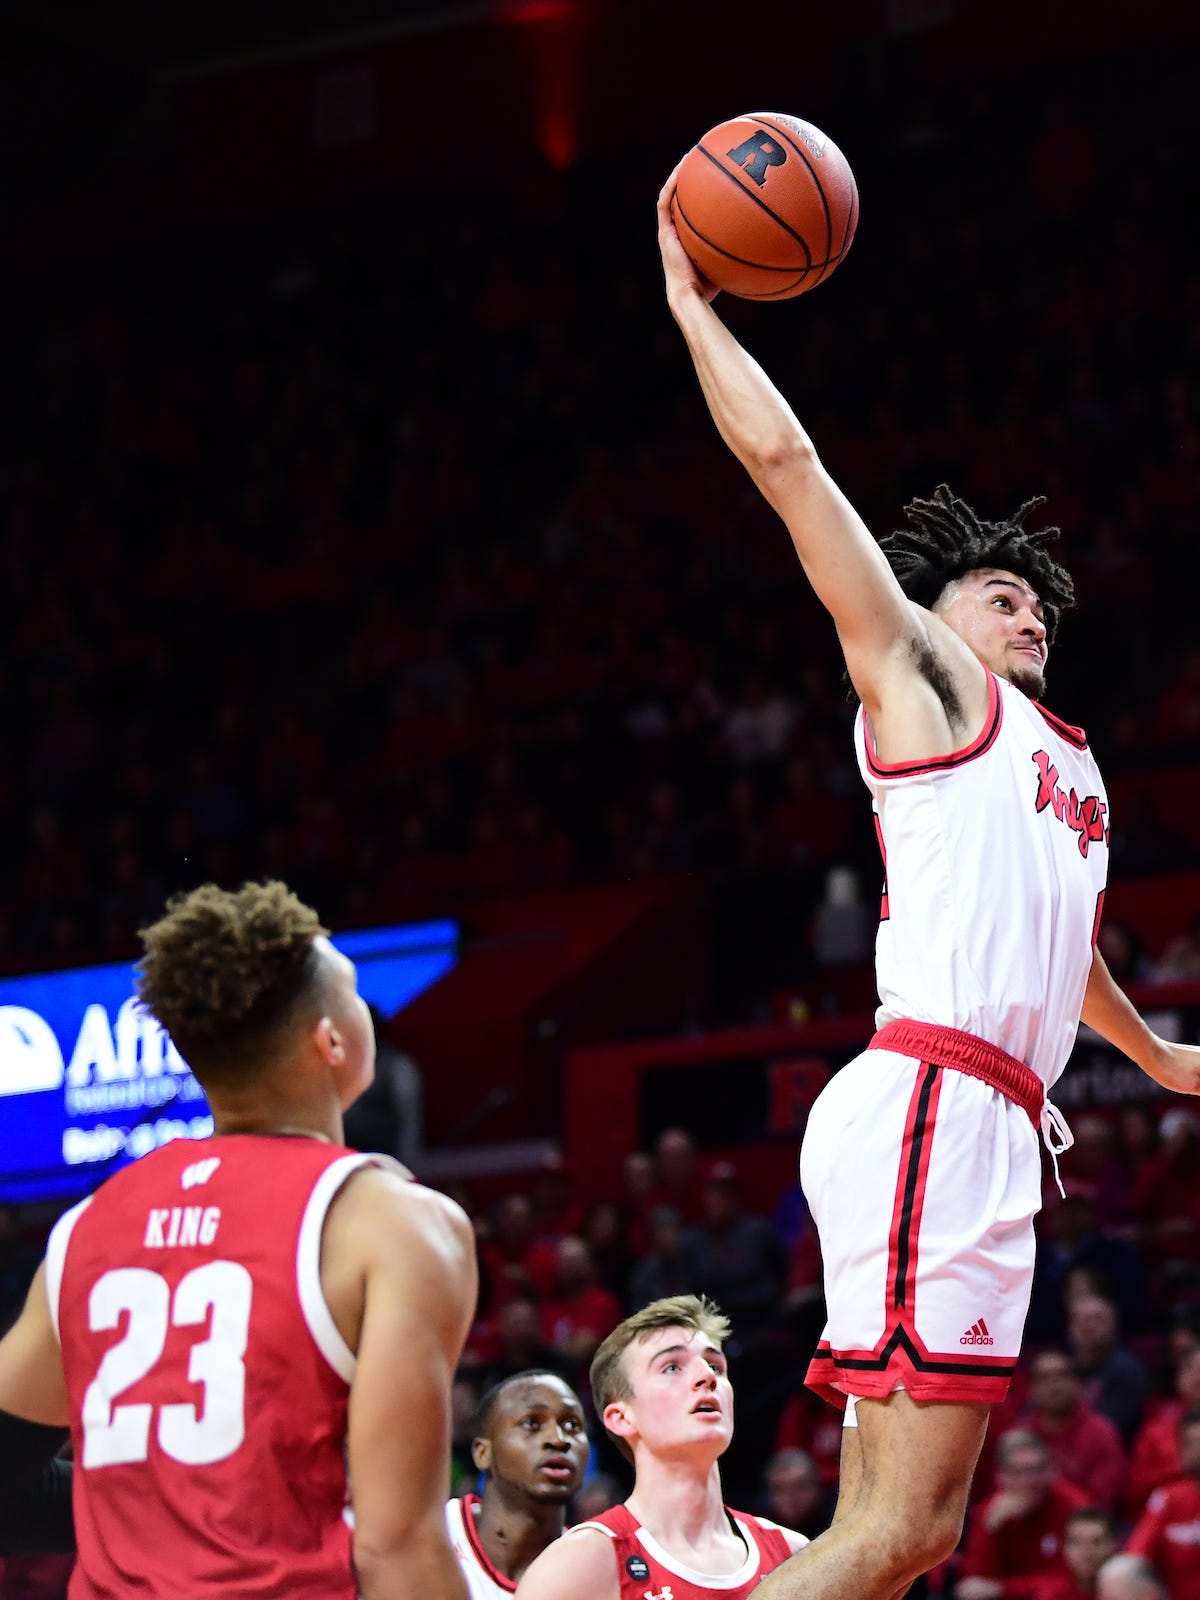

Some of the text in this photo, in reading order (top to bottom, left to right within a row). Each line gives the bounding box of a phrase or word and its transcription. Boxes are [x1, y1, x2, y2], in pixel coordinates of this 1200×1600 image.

[727, 129, 788, 189] R
[144, 1206, 221, 1249] KING
[82, 1260, 253, 1470] 23
[959, 1335, 994, 1346] adidas
